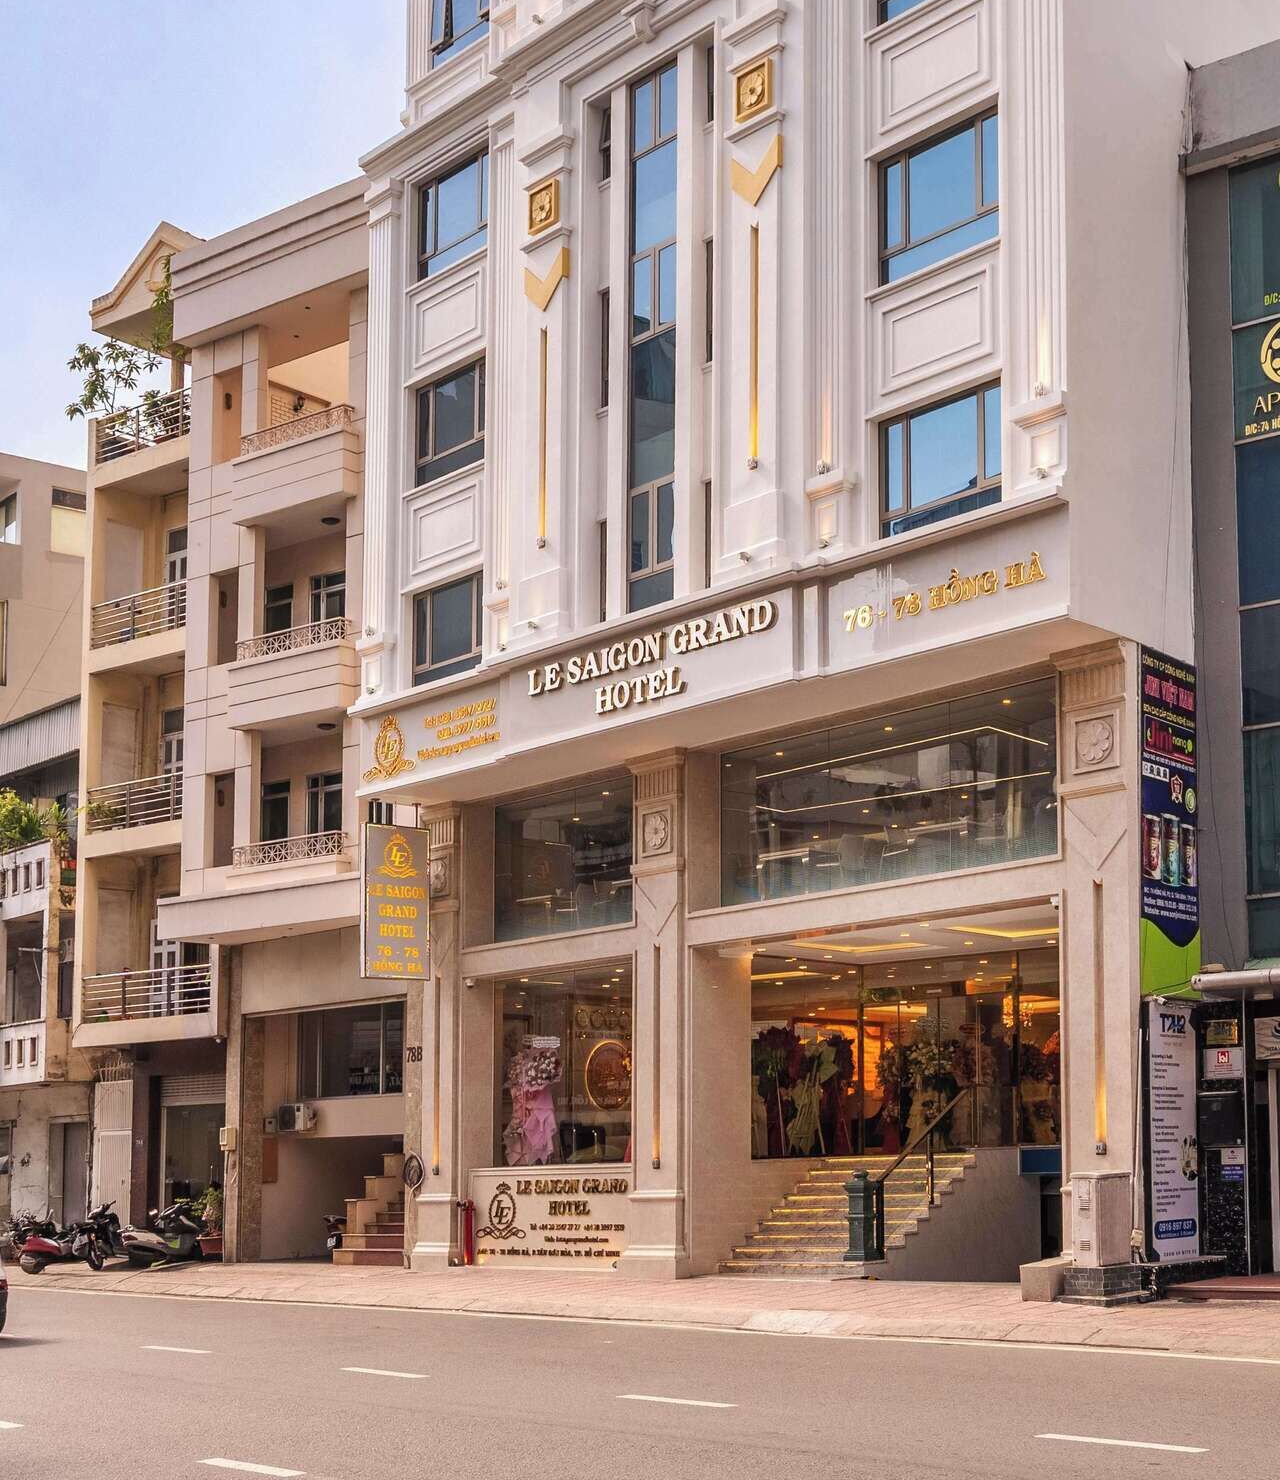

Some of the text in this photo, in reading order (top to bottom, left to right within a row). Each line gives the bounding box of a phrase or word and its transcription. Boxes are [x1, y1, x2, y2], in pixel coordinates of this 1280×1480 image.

[843, 551, 1047, 632] 76 78 HỒNG HÀ
[528, 600, 776, 696] LE SAIGON GRAND
[595, 666, 685, 714] HOTEL
[386, 885, 425, 900] SAIGON
[379, 904, 417, 918] GRAND
[380, 924, 415, 938] HOTEL
[516, 1179, 628, 1194] LE SAIGON GRAND
[548, 1201, 590, 1216] HOTEL
